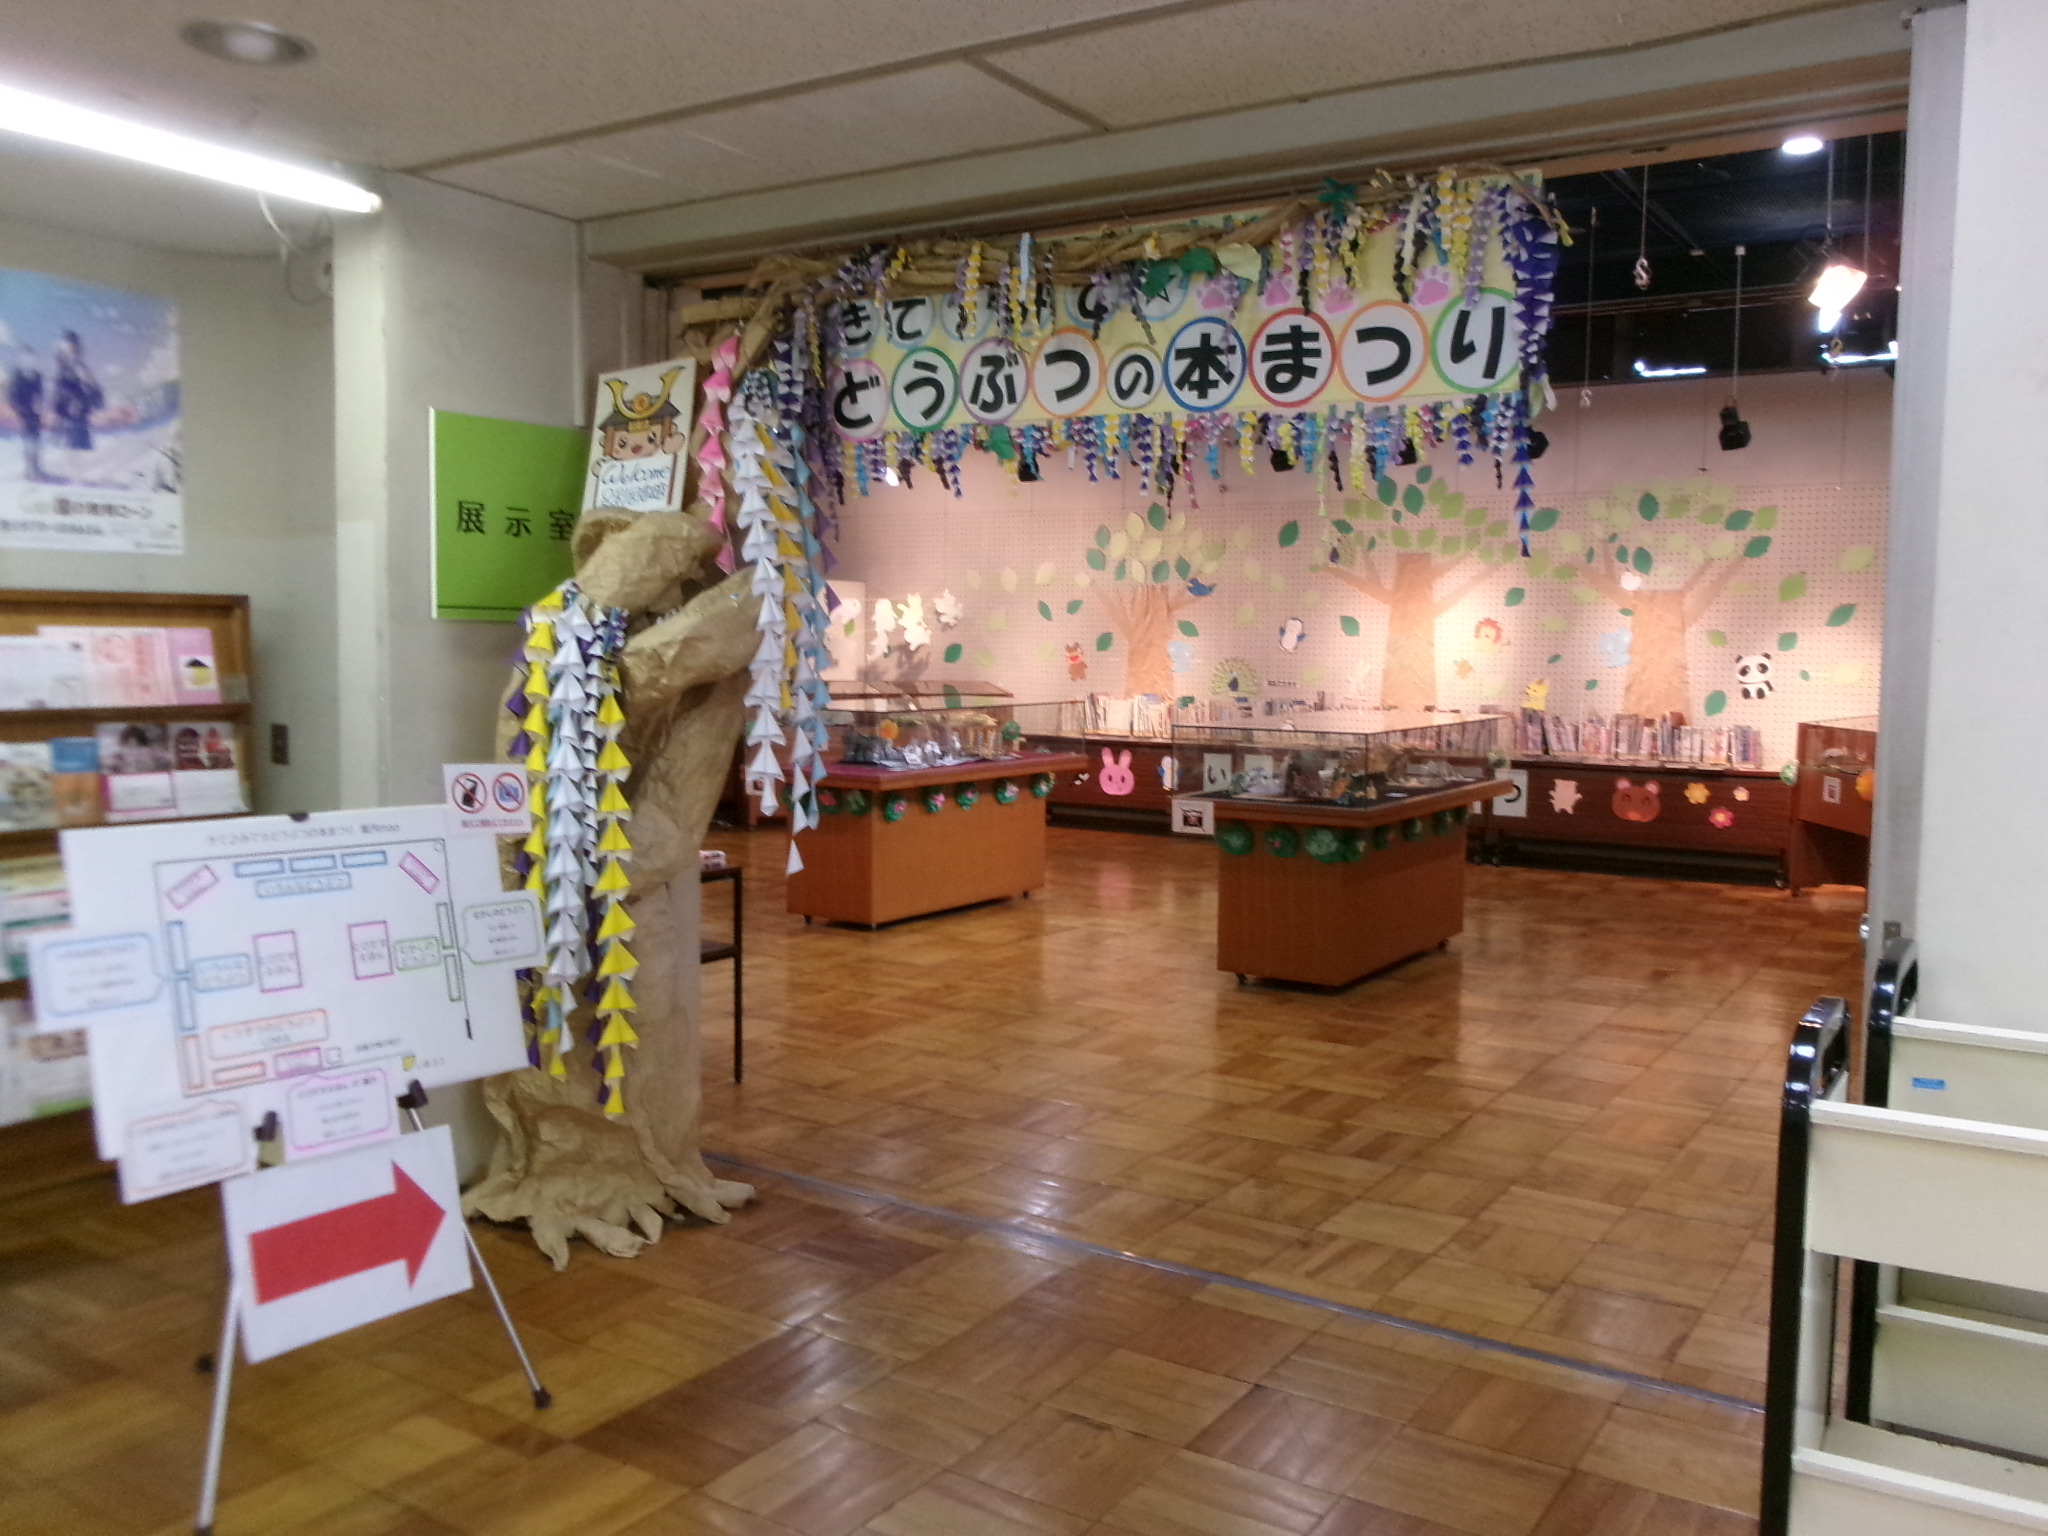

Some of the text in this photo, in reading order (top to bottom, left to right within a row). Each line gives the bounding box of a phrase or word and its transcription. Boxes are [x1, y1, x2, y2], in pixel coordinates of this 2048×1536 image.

[834, 306, 1506, 429] どうぶつの本まつり
[457, 501, 575, 541] 展示室
